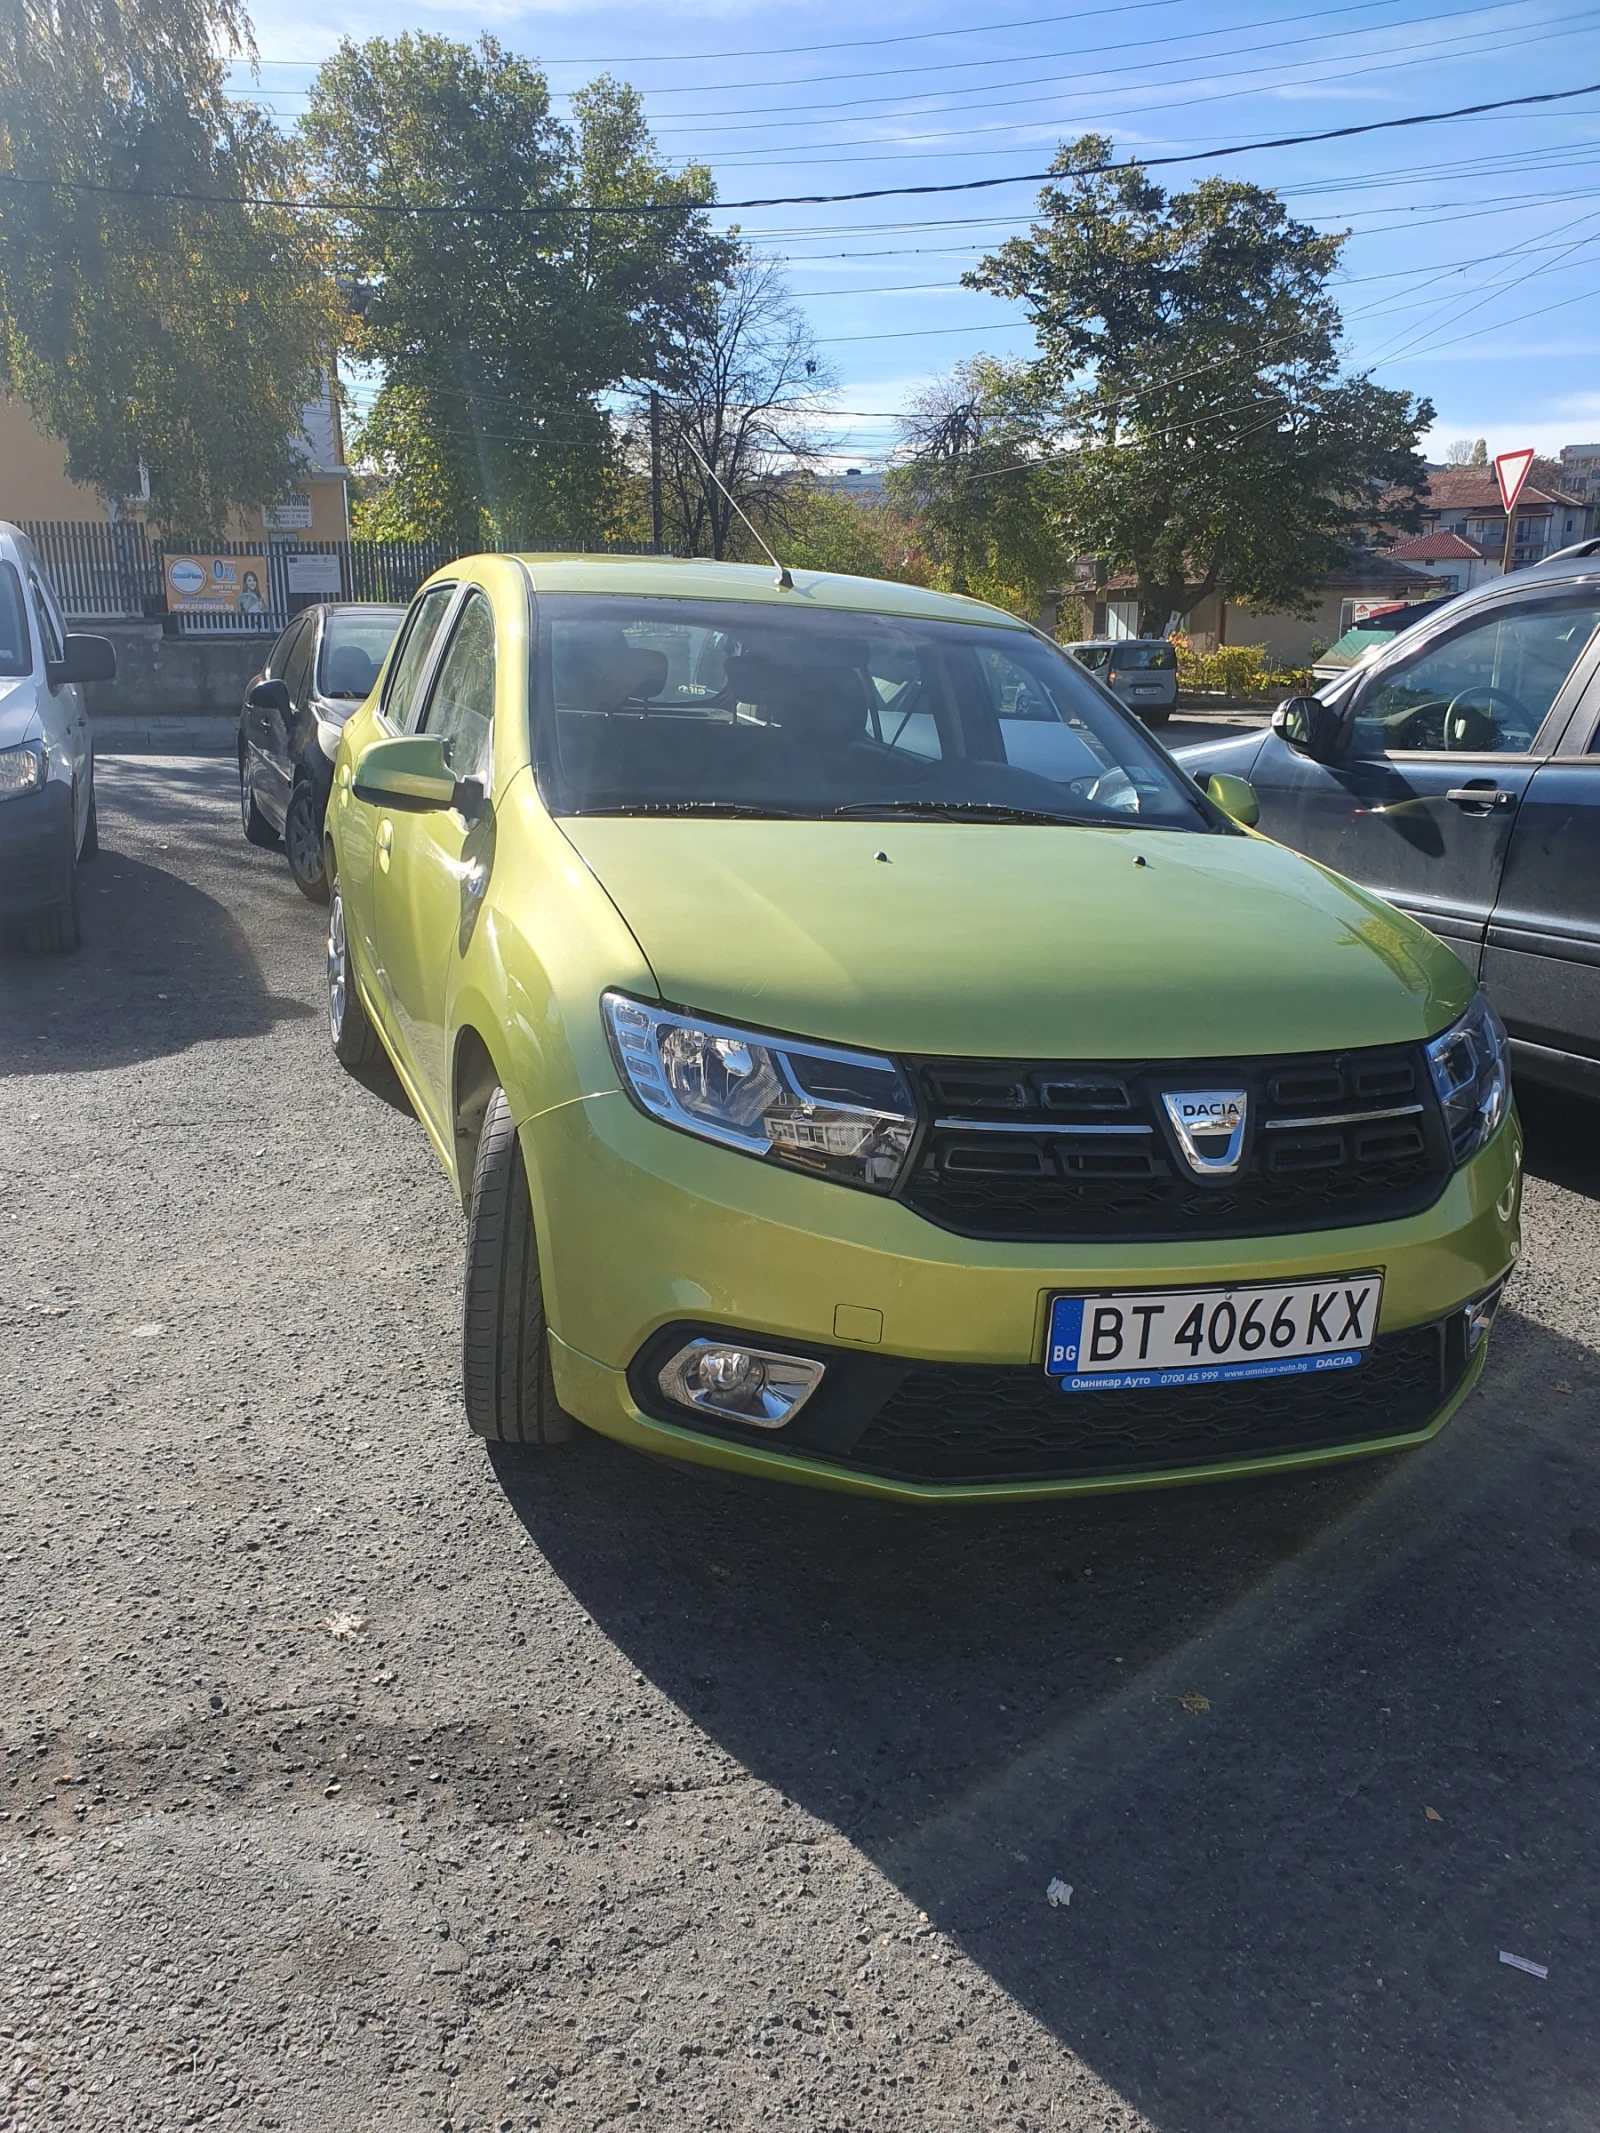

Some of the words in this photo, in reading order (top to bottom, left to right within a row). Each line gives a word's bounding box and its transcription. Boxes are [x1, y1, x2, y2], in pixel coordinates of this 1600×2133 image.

[172, 572, 203, 580] CrediPlus
[213, 559, 237, 581] 0%
[1183, 1103, 1239, 1116] DACIA
[1089, 1305, 1165, 1362] BT
[1174, 1295, 1296, 1356] 4066
[1306, 1287, 1370, 1345] KX
[1053, 1345, 1077, 1362] BG
[1071, 1377, 1121, 1389] Омникар
[1123, 1376, 1150, 1388] Ауто
[1160, 1373, 1185, 1383] 0700
[1186, 1373, 1199, 1382] 45
[1201, 1371, 1219, 1380] 999
[1224, 1362, 1308, 1378] www.omnicar-auto.bg
[1315, 1356, 1353, 1369] DACIA
